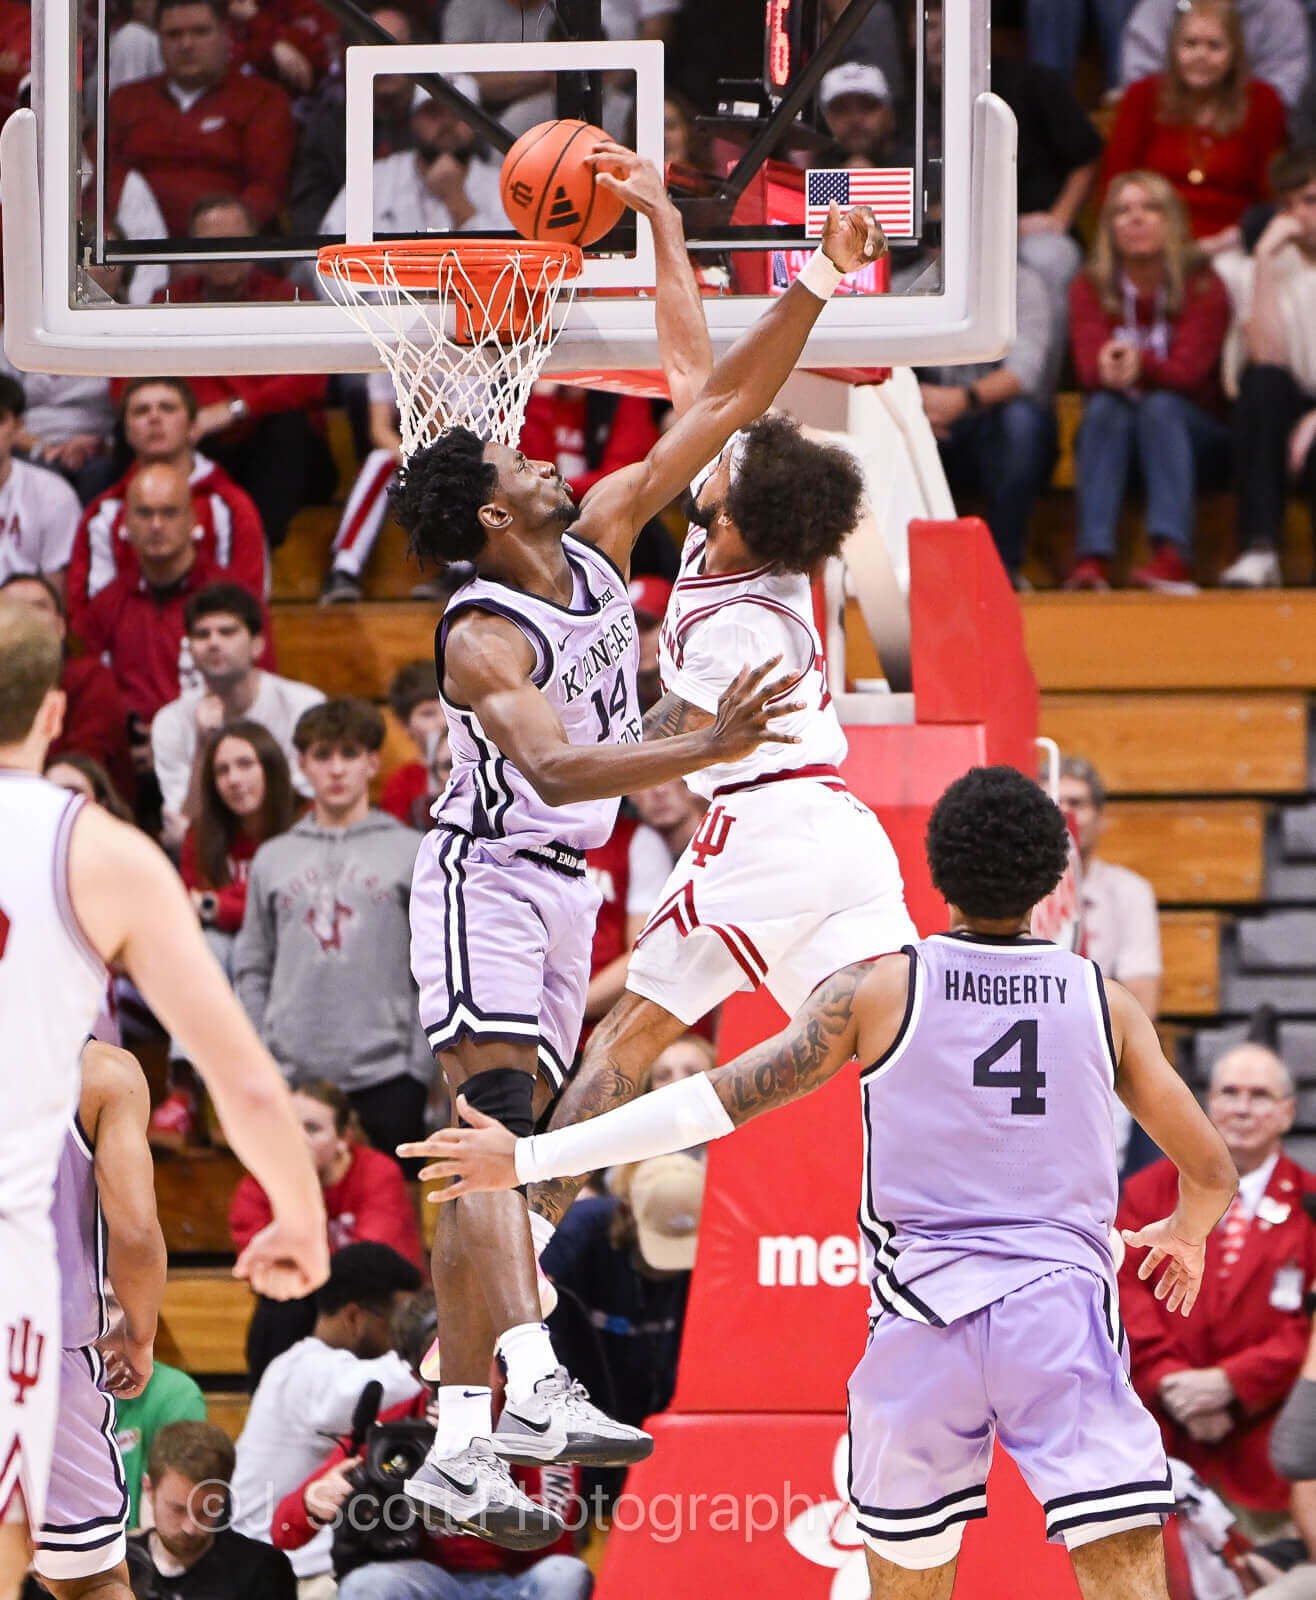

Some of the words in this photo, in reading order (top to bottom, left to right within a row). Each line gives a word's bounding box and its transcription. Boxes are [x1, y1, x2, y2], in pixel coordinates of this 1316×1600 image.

[561, 613, 634, 704] KANSAS
[590, 666, 628, 743] 14
[945, 969, 1068, 1006] HAGGERTY
[972, 1019, 1047, 1116] 4
